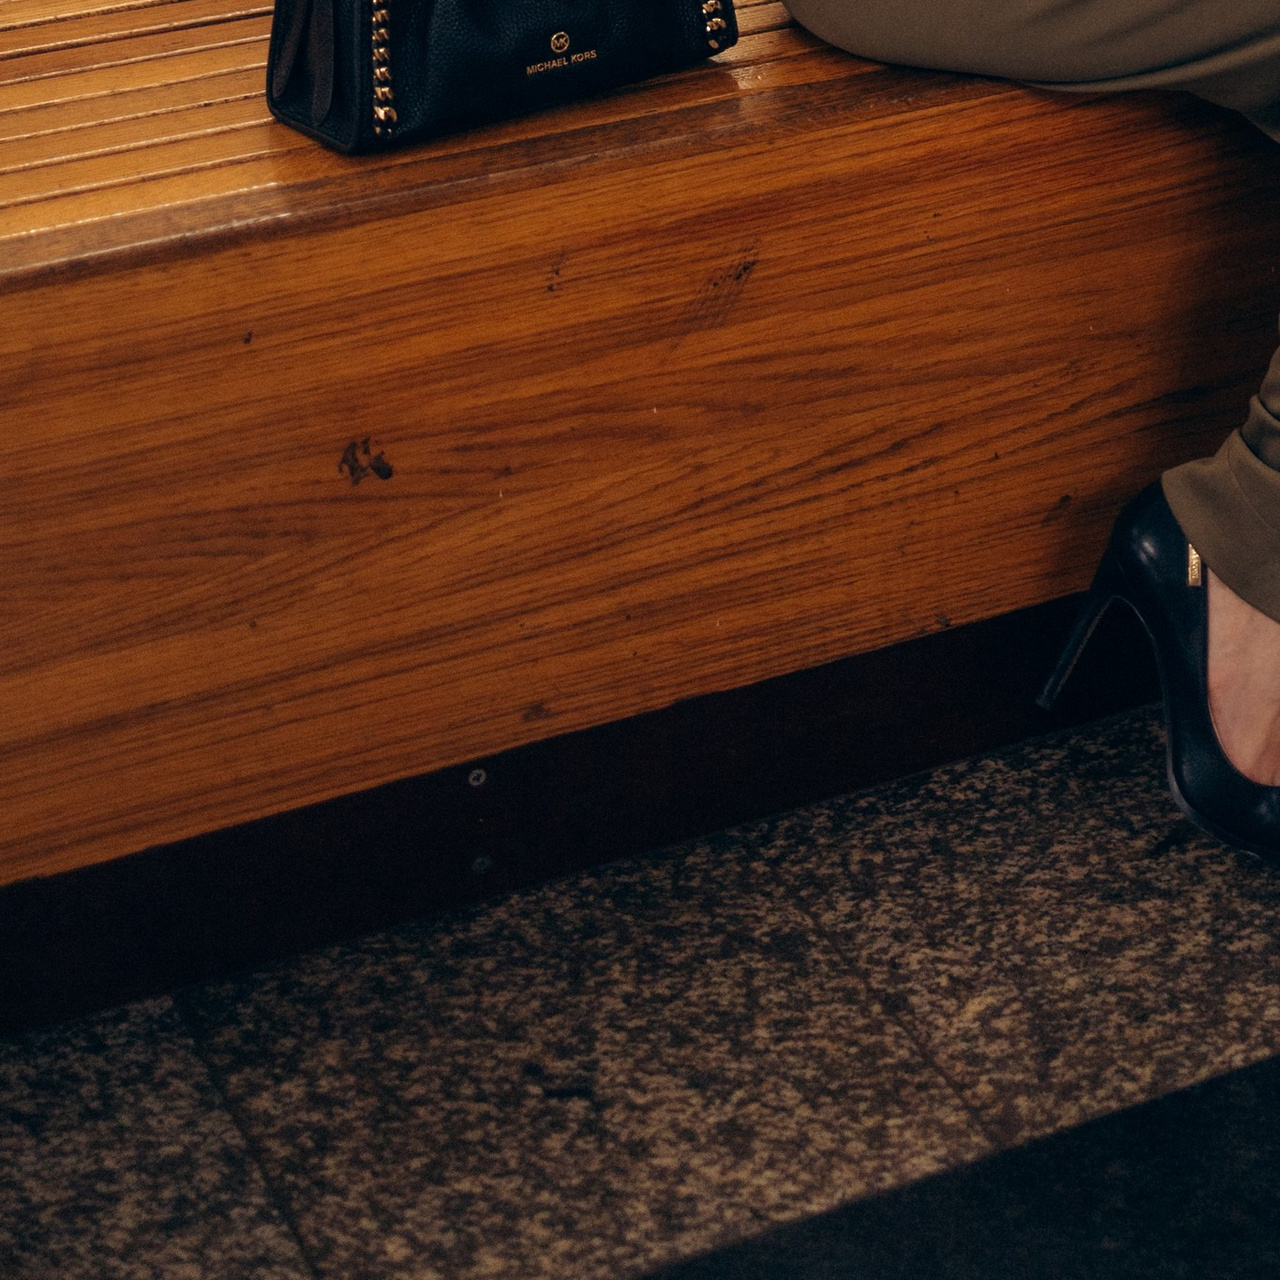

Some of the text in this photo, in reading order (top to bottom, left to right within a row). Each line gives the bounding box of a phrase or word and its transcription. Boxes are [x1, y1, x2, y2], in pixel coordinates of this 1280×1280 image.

[551, 34, 570, 50] MK
[526, 50, 597, 75] MICHAEL KORS
